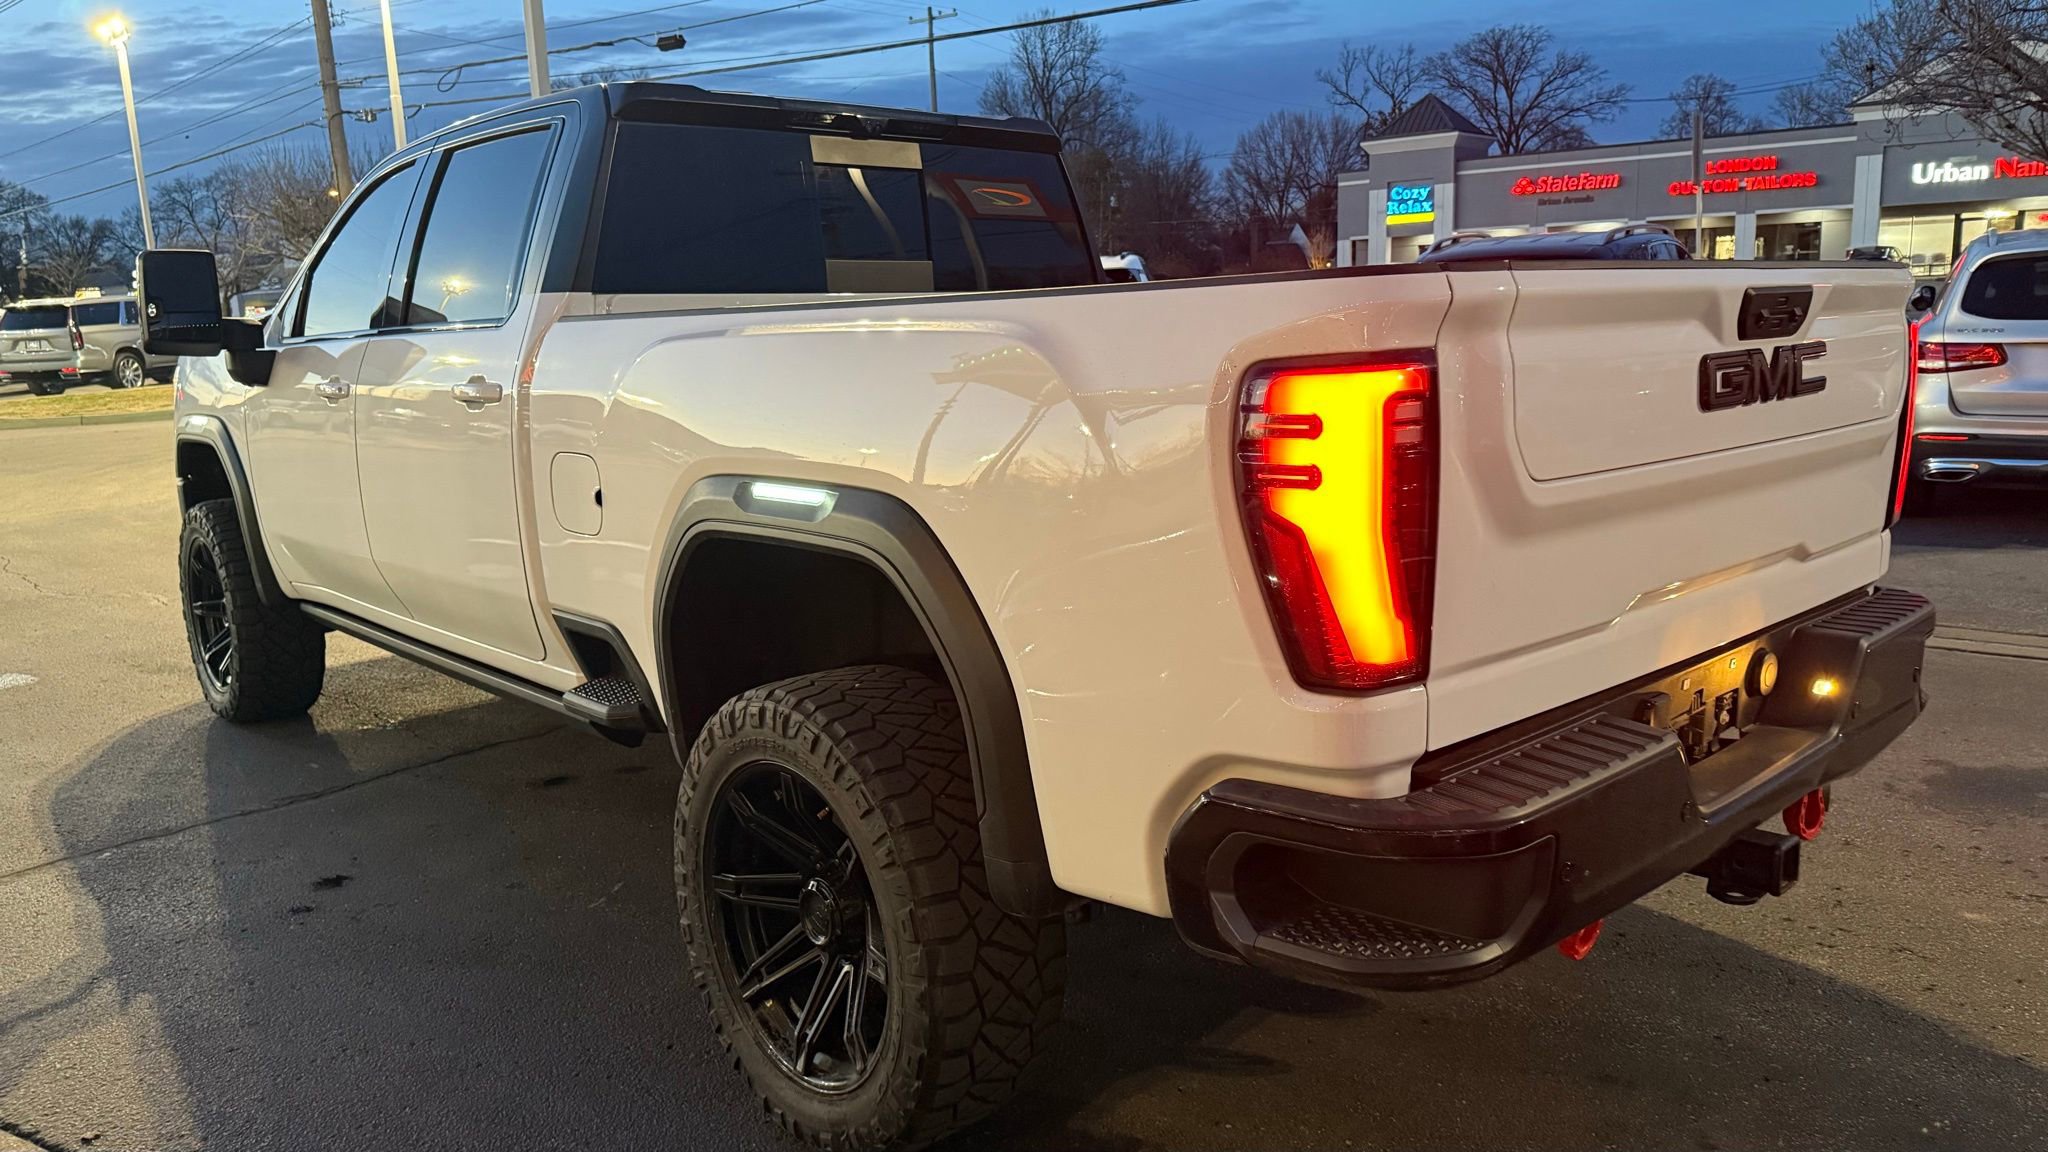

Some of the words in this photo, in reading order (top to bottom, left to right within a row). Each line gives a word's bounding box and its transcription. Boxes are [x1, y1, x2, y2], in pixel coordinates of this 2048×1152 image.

[1706, 156, 1777, 174] LONDON
[1912, 162, 1990, 184] Urban
[1744, 172, 1818, 190] TAILORS
[1391, 186, 1431, 200] Cozy
[1386, 200, 1433, 214] Relax
[1698, 341, 1827, 413] GMC
